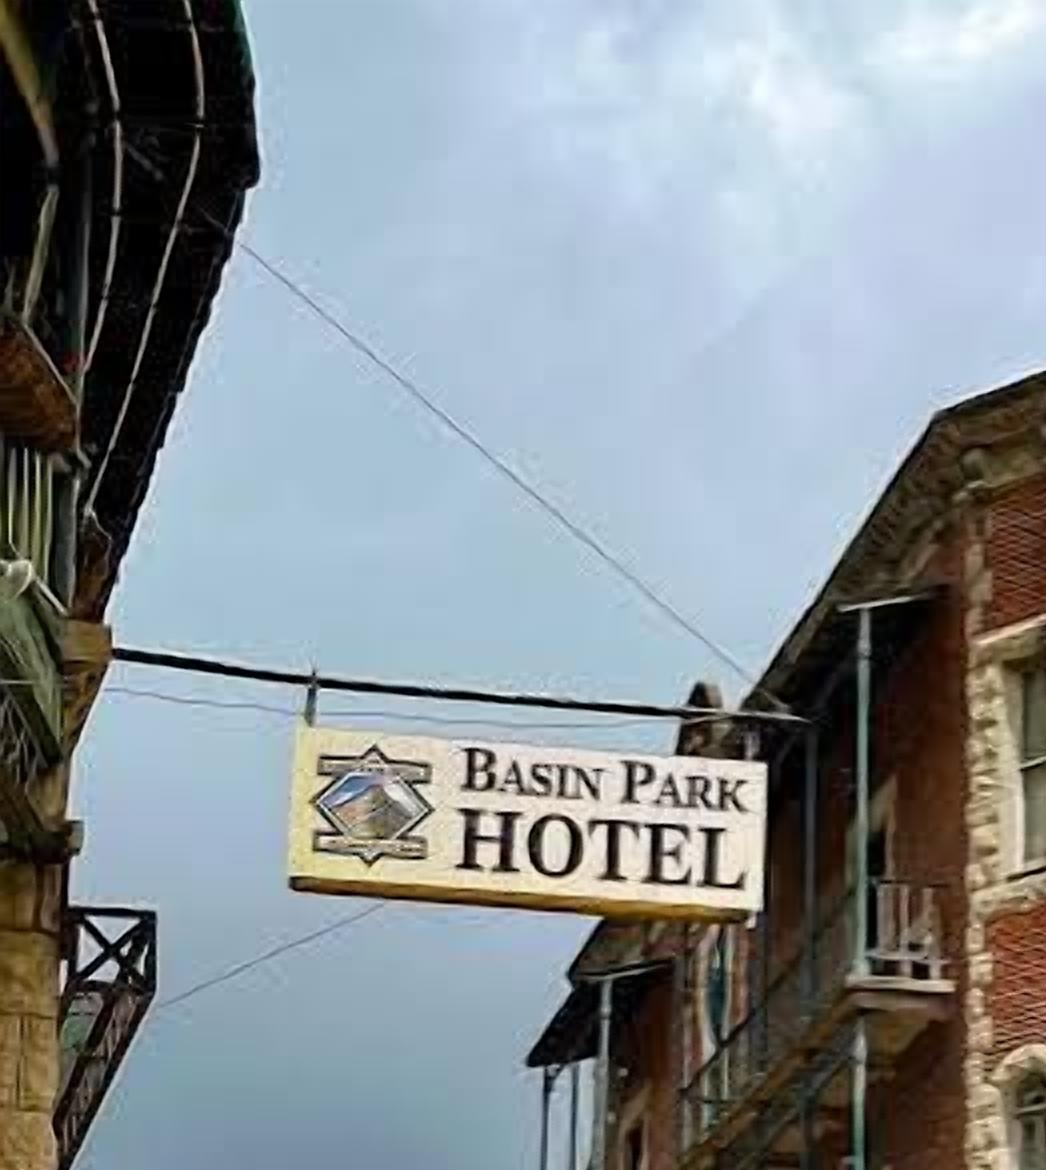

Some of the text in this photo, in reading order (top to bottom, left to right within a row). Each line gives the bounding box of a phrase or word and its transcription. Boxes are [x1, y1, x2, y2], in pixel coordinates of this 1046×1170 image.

[460, 747, 609, 800] BASIN
[619, 759, 749, 813] PARK
[454, 808, 748, 890] HOTEL
